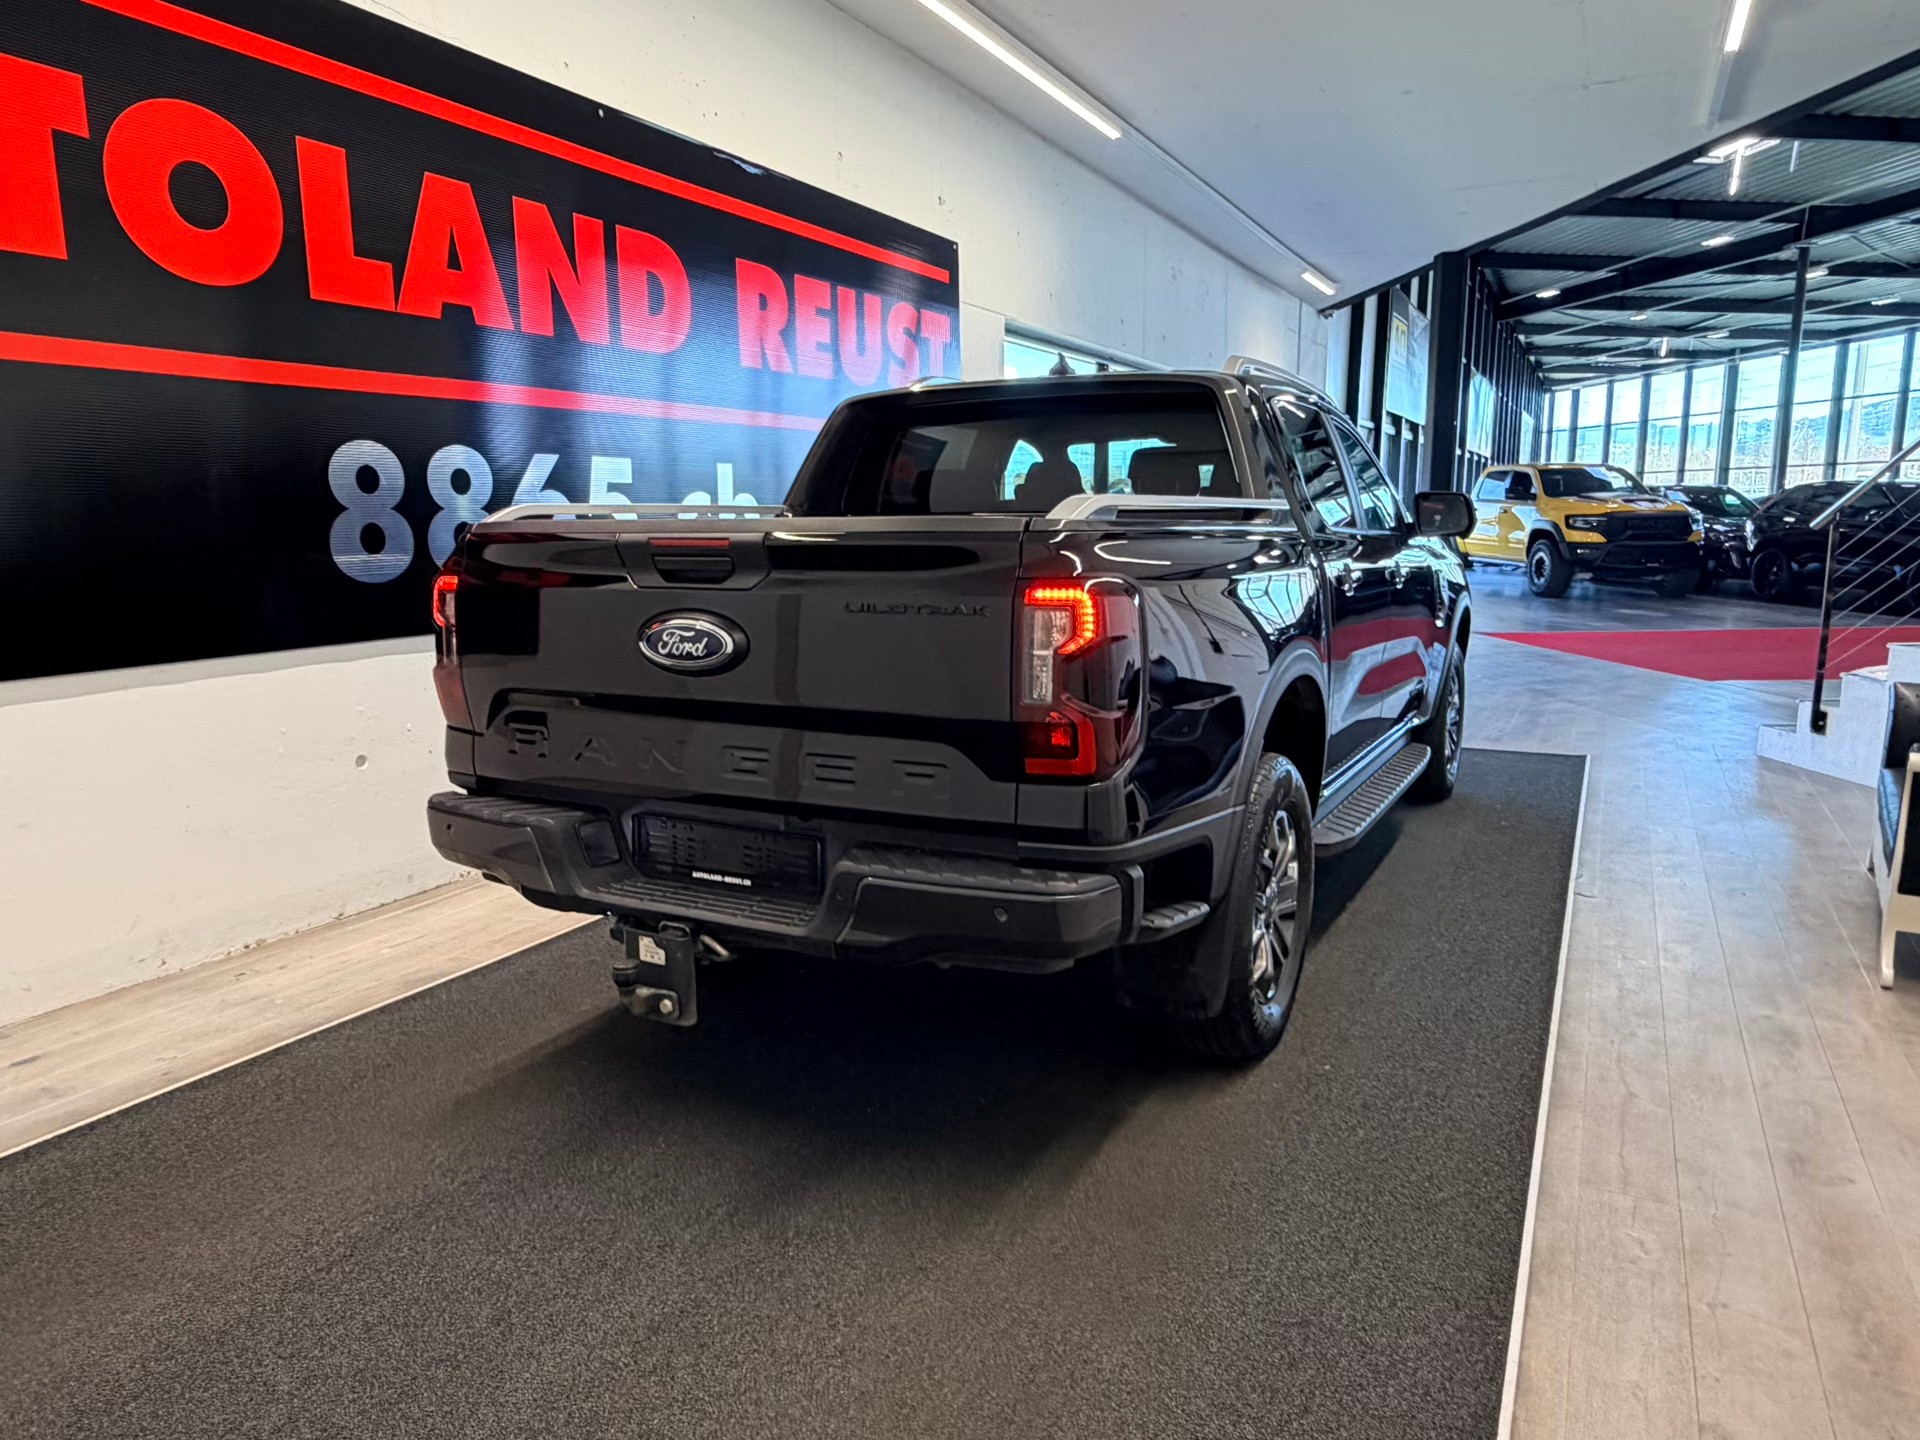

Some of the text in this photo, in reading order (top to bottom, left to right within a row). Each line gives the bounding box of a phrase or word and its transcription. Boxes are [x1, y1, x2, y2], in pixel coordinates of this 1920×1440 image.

[736, 258, 952, 387] REUST
[657, 629, 709, 657] Ford
[504, 711, 949, 798] RANGER
